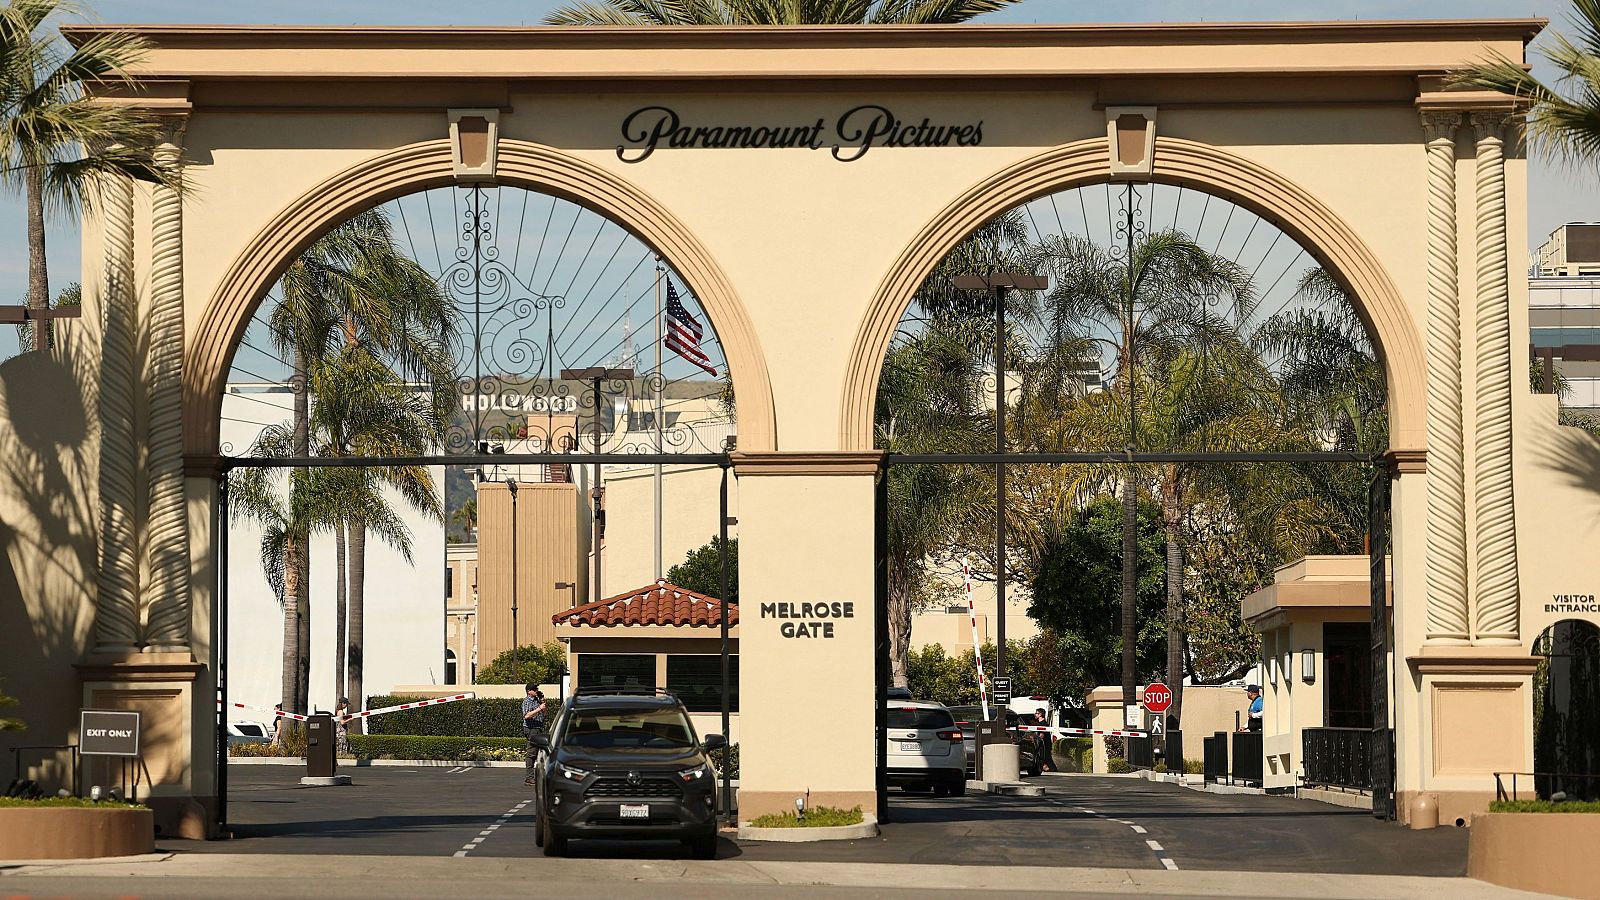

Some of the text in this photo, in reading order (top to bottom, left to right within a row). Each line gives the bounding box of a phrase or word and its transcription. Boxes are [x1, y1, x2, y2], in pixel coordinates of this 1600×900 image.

[616, 105, 984, 164] Paramount Pictures
[462, 394, 578, 412] HOLLYWOOD
[1552, 594, 1596, 603] VISITOR
[760, 602, 854, 619] MELROSE
[780, 622, 834, 639] GATE
[1144, 692, 1170, 704] STOP
[86, 729, 132, 738] EXIT ONLY
